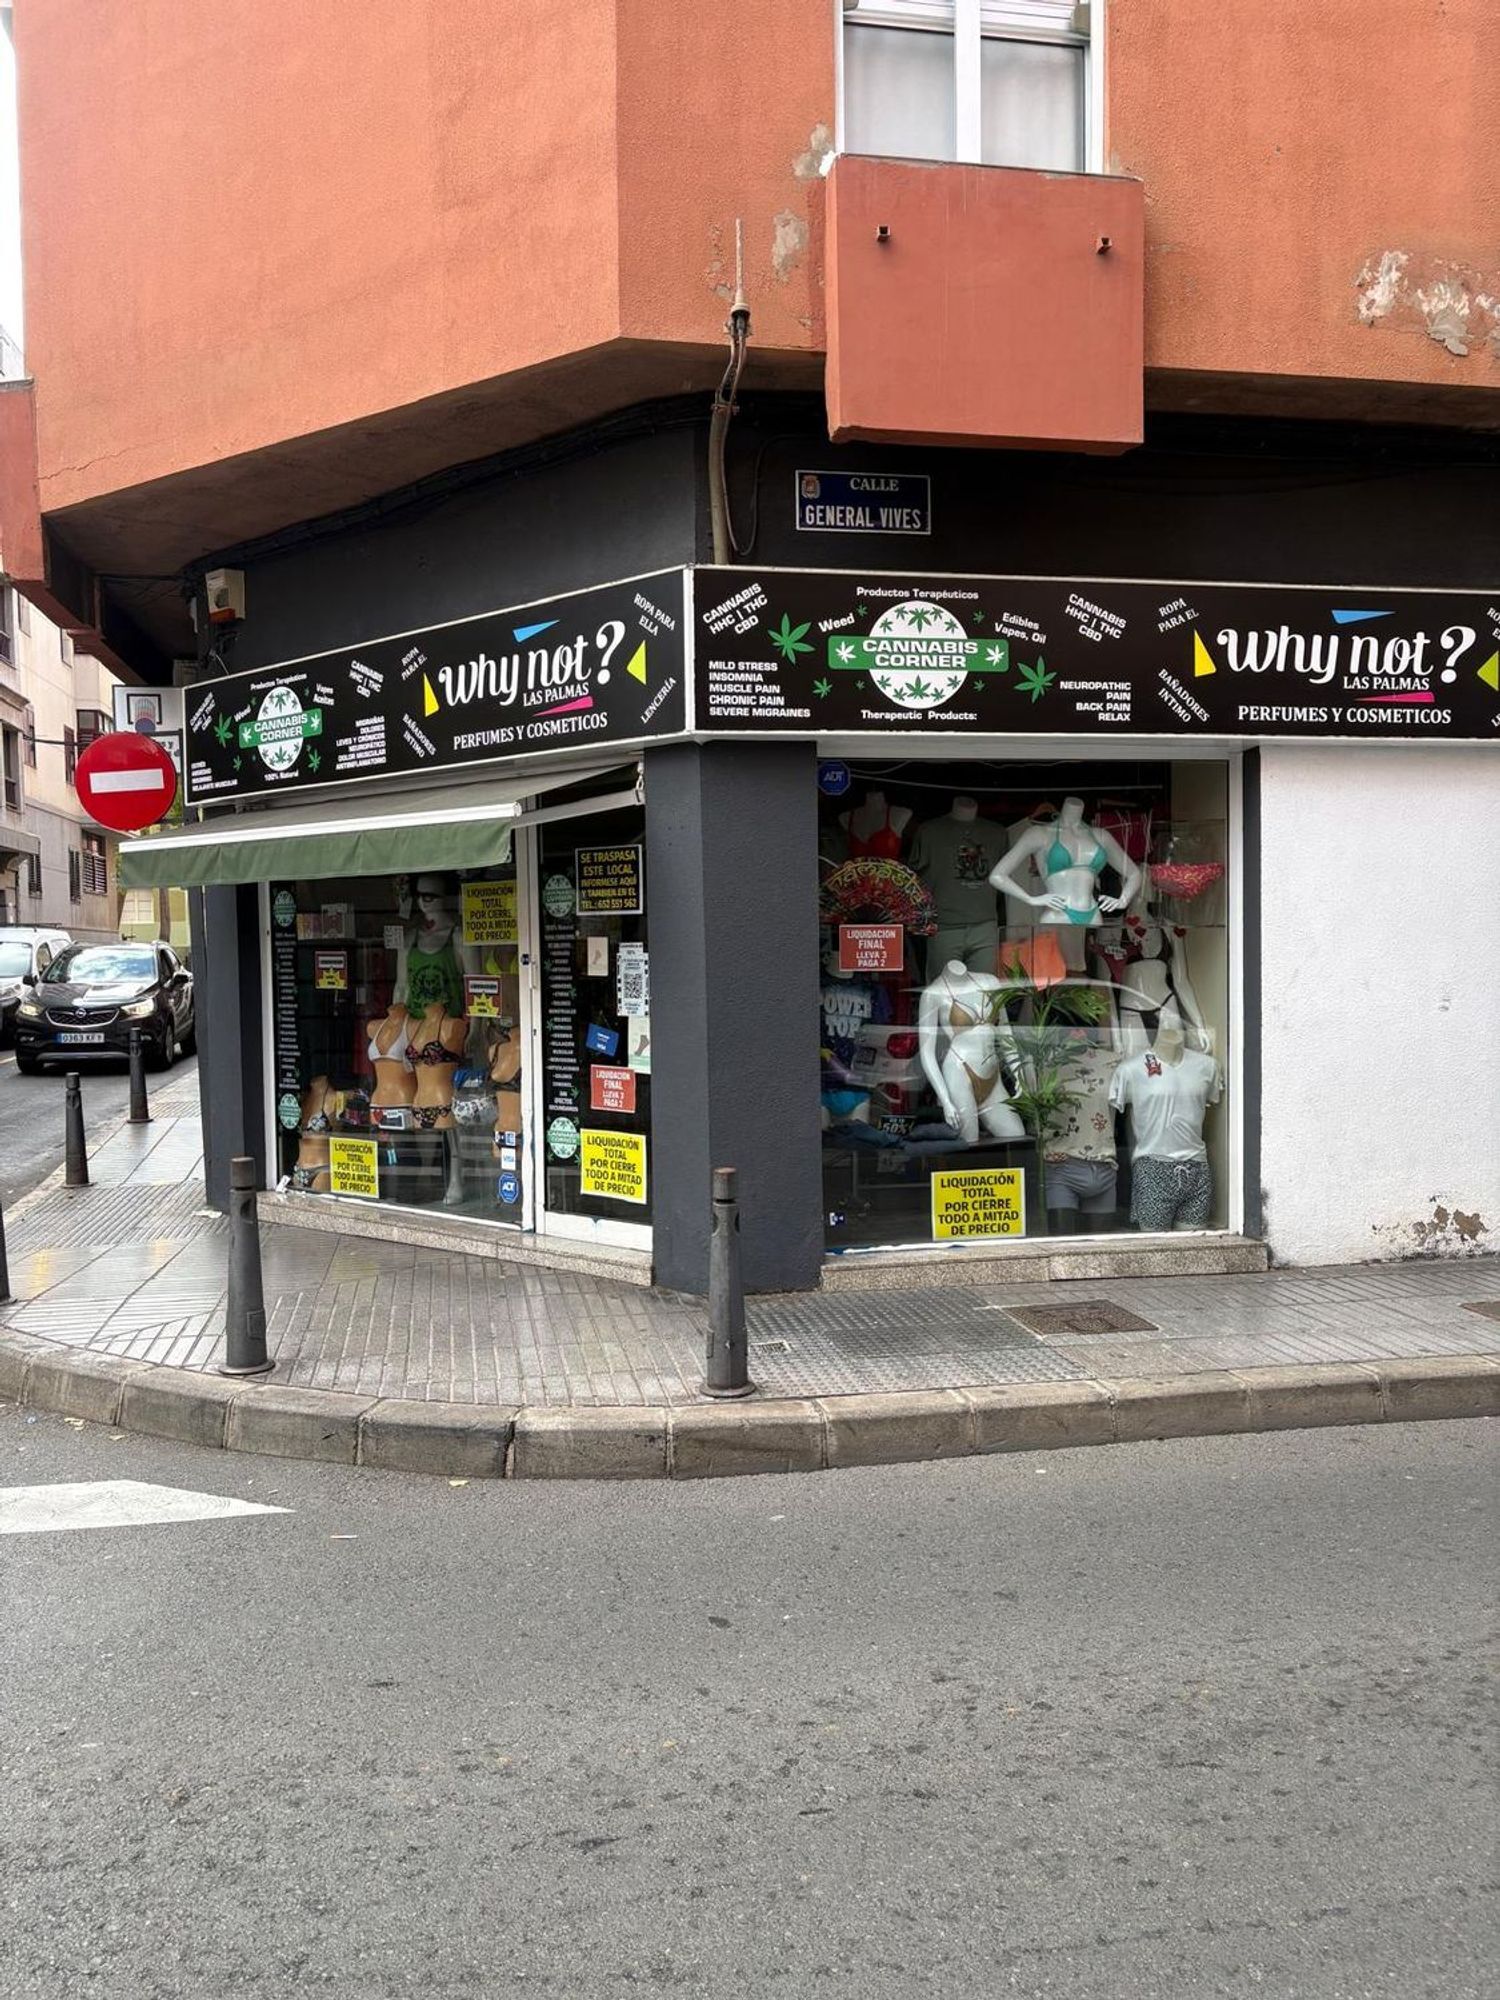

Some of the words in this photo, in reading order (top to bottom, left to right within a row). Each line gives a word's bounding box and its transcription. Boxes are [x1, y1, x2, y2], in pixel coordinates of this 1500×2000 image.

[850, 477, 899, 491] CALLE
[805, 504, 874, 527] GENERAL
[879, 507, 921, 529] VIVES
[856, 586, 910, 597] Productos
[912, 588, 979, 600] Terapéuticos
[702, 583, 762, 623] CANNABIS
[1159, 597, 1187, 617] ROPA
[634, 592, 655, 616] ROPA
[654, 609, 676, 631] PARA
[709, 614, 735, 634] HHC
[743, 594, 768, 614] THC
[1069, 593, 1127, 628] CANNABIS
[639, 615, 659, 636] ELLA
[734, 615, 759, 634] CBD
[818, 613, 855, 633] Weed
[1002, 612, 1040, 630] Edibles
[1064, 604, 1090, 623] HHC
[1099, 620, 1122, 639] THC
[1157, 614, 1185, 633] PARA
[1185, 608, 1199, 620] EL
[994, 623, 1029, 641] Vapes,
[1031, 633, 1047, 645] Oil
[1078, 624, 1102, 642] CBD
[862, 640, 979, 654] CANNABIS
[709, 661, 735, 670] MILD
[738, 662, 778, 671] STRESS
[875, 655, 967, 668] CORNER
[709, 672, 763, 682] INSOMNIA
[1343, 676, 1370, 689] LAS
[1373, 676, 1430, 690] PALMAS
[709, 684, 752, 693] MUSCLE
[755, 684, 780, 693] PAIN
[1060, 681, 1131, 690] NEUROPATHIC
[523, 691, 543, 707] LAS
[545, 682, 589, 702] PALMAS
[640, 677, 677, 724] LENCERÍA
[709, 695, 757, 705] CHRONIC
[759, 696, 784, 706] PAIN
[1106, 692, 1131, 701] PAIN
[1158, 668, 1210, 722] BAÑADORES
[709, 707, 749, 716] SEVERE
[752, 708, 811, 717] MIGRAINES
[1075, 702, 1103, 711] BACK
[1106, 702, 1131, 711] PAIN
[1158, 688, 1191, 722] INTIMO
[860, 710, 922, 721] Therapeutic
[927, 711, 978, 720] Products:
[1098, 713, 1131, 721] RELAX
[1238, 706, 1328, 722] PERFUMES
[1331, 707, 1343, 722] Y
[1347, 707, 1452, 724] COSMETICOS
[254, 714, 308, 732] CANNABIS
[260, 726, 302, 743] CORNER
[453, 727, 514, 750] PERFUMES
[516, 724, 524, 740] Y
[527, 712, 608, 738] COSMETICOS
[580, 852, 592, 863] SE
[592, 850, 636, 862] TRASPASA
[583, 865, 604, 876] ESTE
[606, 864, 634, 875] LOCAL
[858, 939, 885, 949] FINAL
[856, 951, 880, 959] LLEVA
[881, 951, 888, 959] 3
[858, 959, 879, 967] PAGA
[880, 959, 886, 967] 2
[586, 1135, 640, 1150] LIQUIDACIÓN
[346, 1153, 364, 1163] TOTAL
[603, 1148, 627, 1160] TOTAL
[337, 1162, 350, 1170] POR
[351, 1163, 370, 1174] CIERRE
[590, 1158, 608, 1168] POR
[610, 1160, 637, 1173] CIERRE
[333, 1170, 351, 1181] TODO
[352, 1173, 356, 1181] A
[356, 1173, 375, 1183] MITAD
[585, 1168, 609, 1180] TODO
[610, 1172, 616, 1181] A
[617, 1172, 642, 1185] MITAD
[940, 1172, 1015, 1188] LIQUIDACIÓN
[340, 1181, 348, 1191] DE
[349, 1182, 371, 1193] PRECIO
[594, 1181, 605, 1191] DE
[607, 1182, 635, 1195] PRECIO
[961, 1187, 997, 1199] TOTAL
[945, 1202, 969, 1212] POR
[971, 1198, 1011, 1210] CIERRE
[938, 1213, 970, 1224] TODO
[972, 1212, 980, 1222] A
[983, 1211, 1019, 1222] MITAD
[951, 1225, 966, 1235] DE
[968, 1222, 1010, 1234] PRECIO
